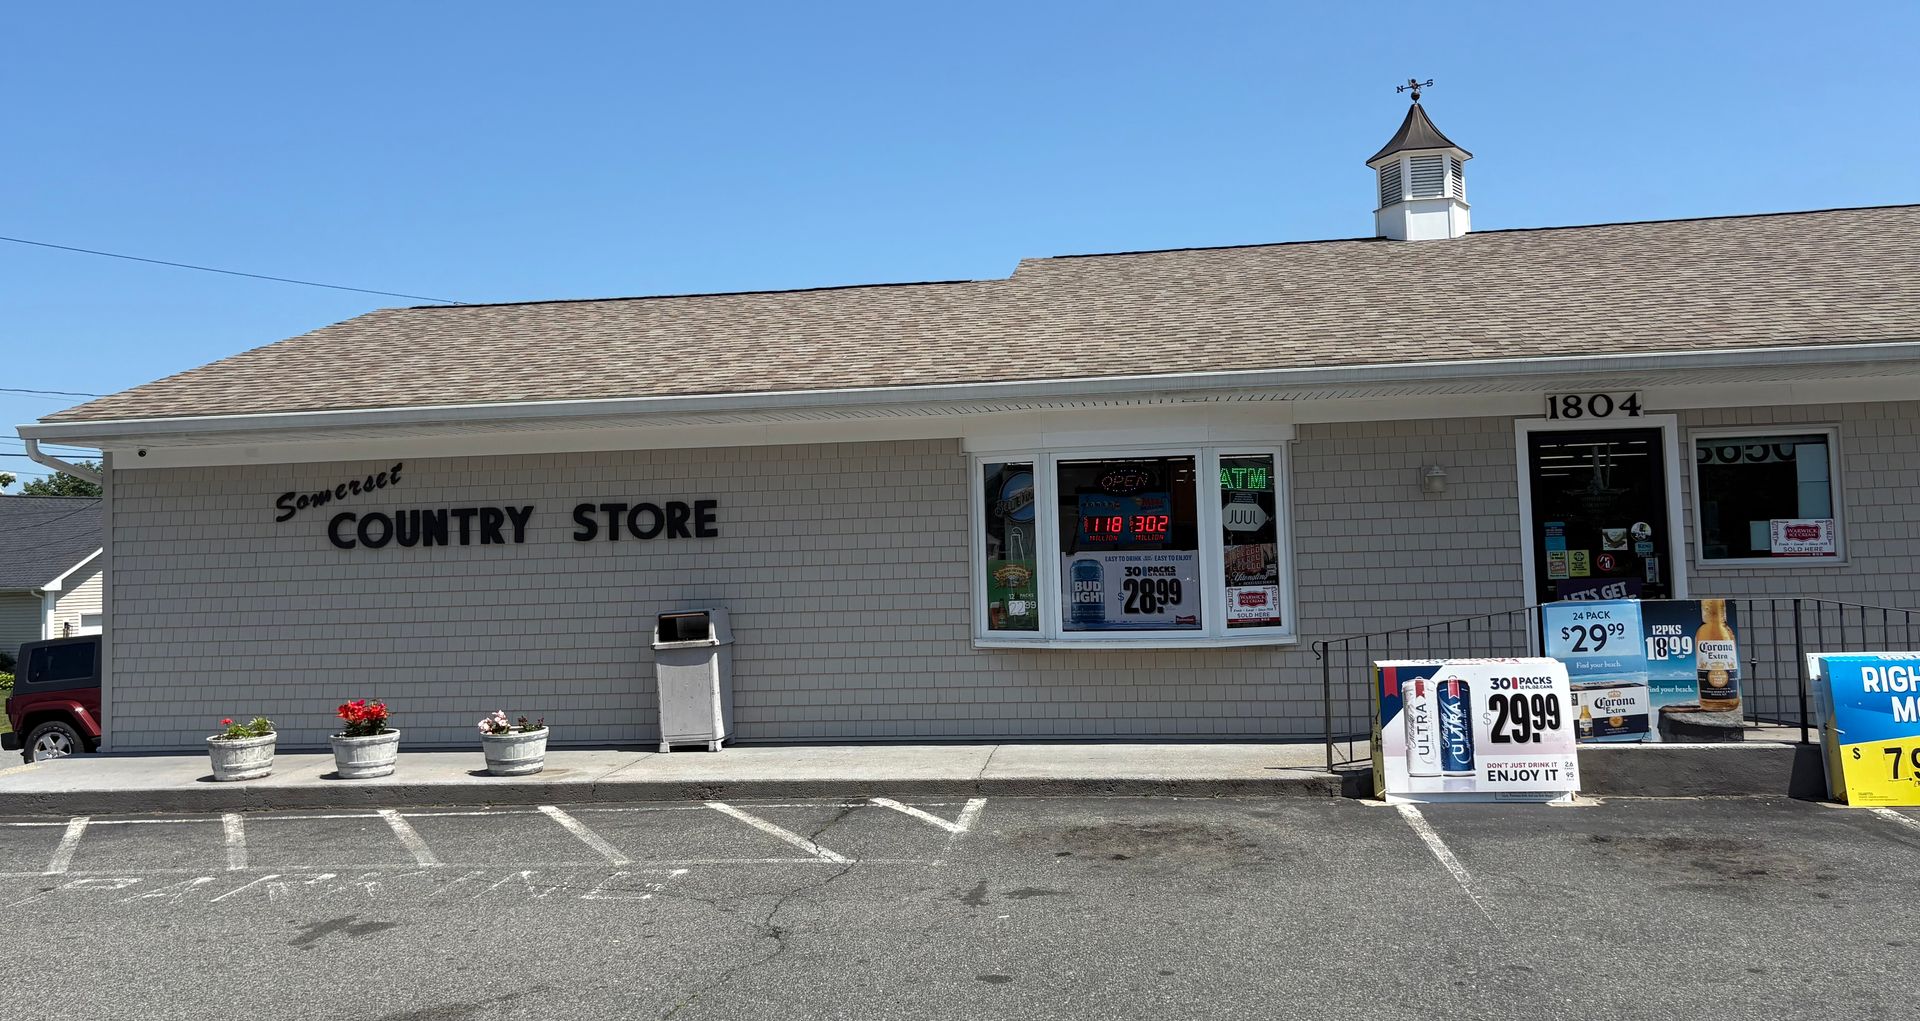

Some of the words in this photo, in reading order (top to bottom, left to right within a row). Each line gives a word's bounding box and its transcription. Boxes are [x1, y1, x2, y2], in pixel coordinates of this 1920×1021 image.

[1396, 85, 1404, 93] N
[1548, 392, 1641, 419] 1804
[1101, 475, 1146, 488] OPEN
[1220, 467, 1266, 489] ATM
[276, 462, 402, 522] Somerset
[1134, 515, 1169, 532] 302
[1228, 510, 1258, 524] JUUL
[328, 505, 534, 550] COUNTRY
[572, 499, 719, 543] STORE
[1124, 566, 1141, 576] 30
[1075, 581, 1101, 592] BUD
[1601, 581, 1626, 599] GET
[1072, 591, 1104, 603] LIGHT
[1573, 612, 1584, 620] 24
[1586, 611, 1611, 620] PACK
[1699, 642, 1733, 654] Corona
[1490, 677, 1511, 690] 30
[1519, 676, 1552, 685] PACKS
[1594, 697, 1635, 710] Corona
[1416, 703, 1430, 755] ULTRA
[1449, 702, 1464, 754] ULTRA
[1853, 747, 1861, 760] $
[1488, 770, 1539, 781] ENJOY
[1545, 770, 1558, 781] IT
